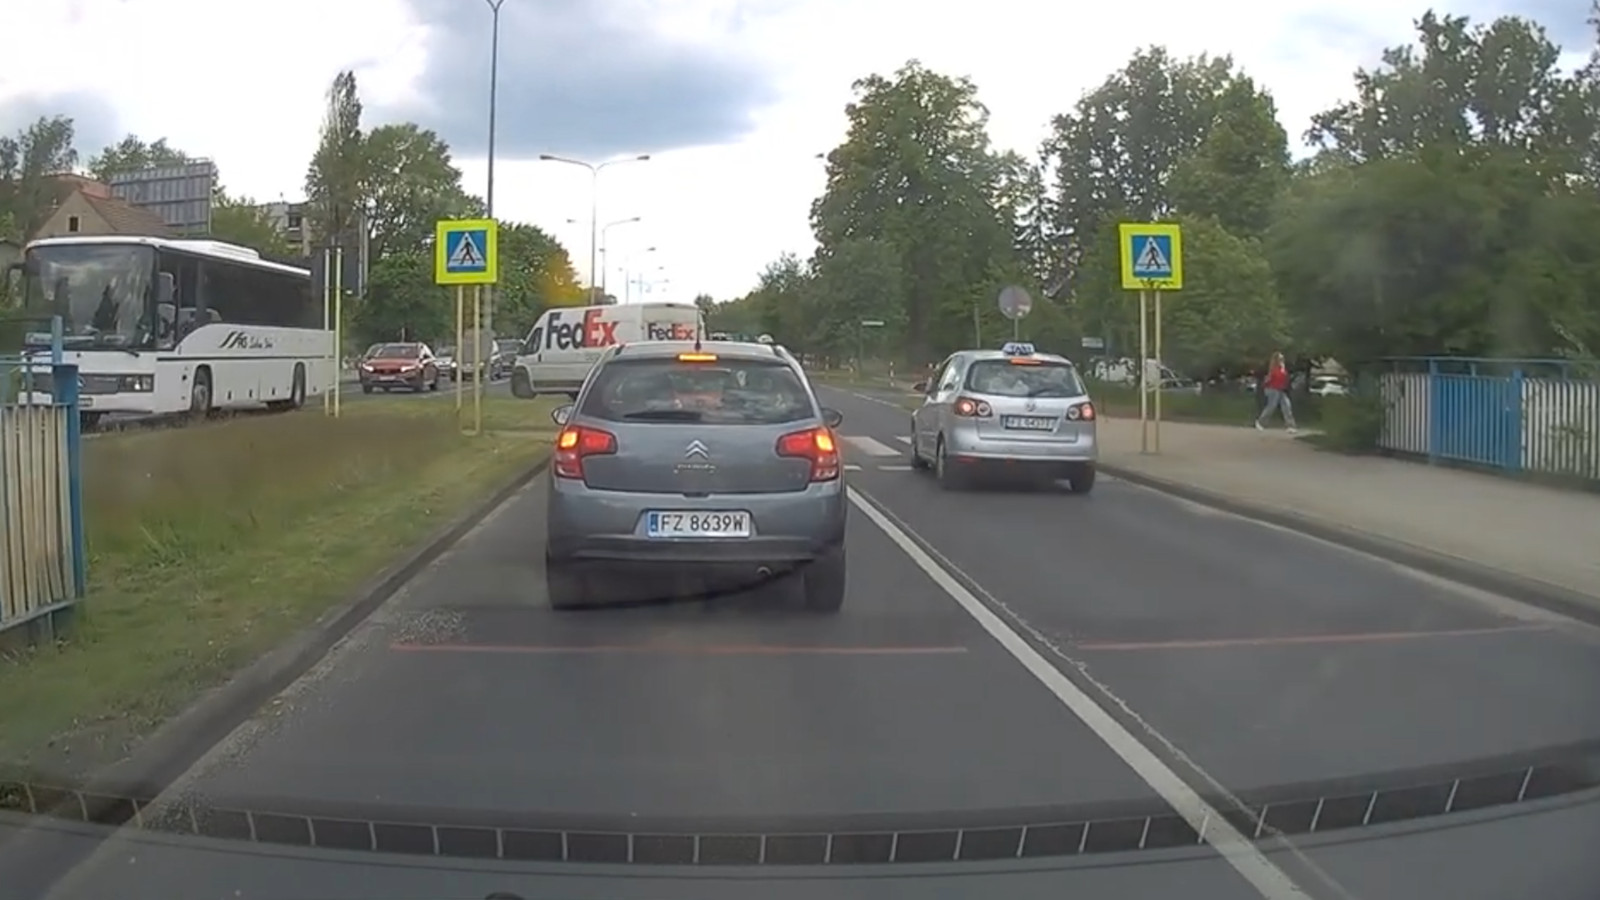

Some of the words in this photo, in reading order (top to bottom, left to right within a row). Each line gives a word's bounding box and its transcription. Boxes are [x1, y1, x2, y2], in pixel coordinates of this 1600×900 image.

[546, 309, 619, 349] FedEx
[648, 323, 694, 340] FedEx
[661, 514, 683, 531] FZ
[690, 514, 743, 531] 8639W
